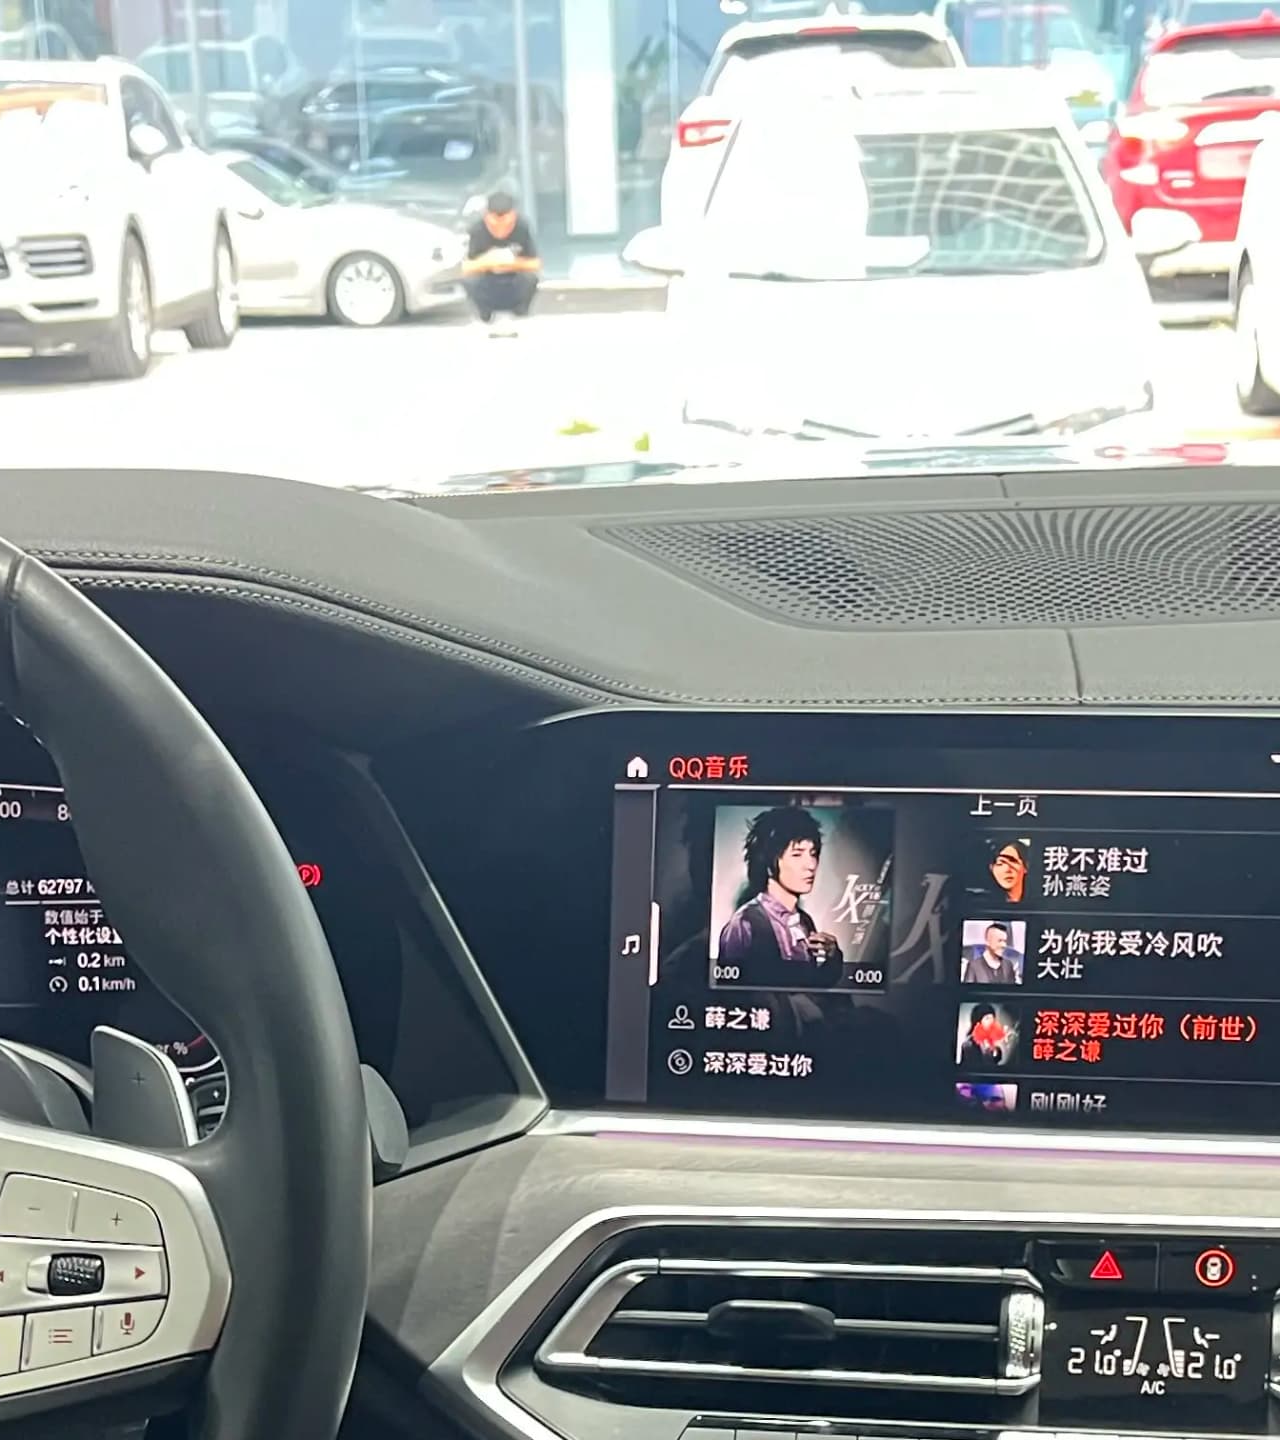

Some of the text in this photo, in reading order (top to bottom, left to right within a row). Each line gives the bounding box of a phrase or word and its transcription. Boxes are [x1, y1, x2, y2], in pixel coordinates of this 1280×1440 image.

[669, 756, 749, 780] QQ音乐
[57, 804, 72, 821] 8
[969, 795, 1039, 817] 上一页
[1043, 846, 1149, 873] 我不难过
[5, 878, 96, 895] 总计 62797 k
[1042, 874, 1112, 897] 孙燕姿
[45, 909, 104, 925] 数值始于
[1038, 928, 1223, 959] 为你我受冷风吹
[77, 953, 126, 968] 0.2 km
[1037, 957, 1084, 979] 大壮
[78, 976, 136, 992] 0.1 km/h
[713, 966, 740, 980] 0:00
[704, 1006, 771, 1030] 薛之谦
[1034, 1010, 1257, 1041] 深深爱过你（前世）
[1032, 1039, 1102, 1063] 薛之谦
[703, 1051, 813, 1077] 深深爱过你
[1030, 1092, 1107, 1113] 刚刚好
[1140, 1380, 1166, 1395] A/C
